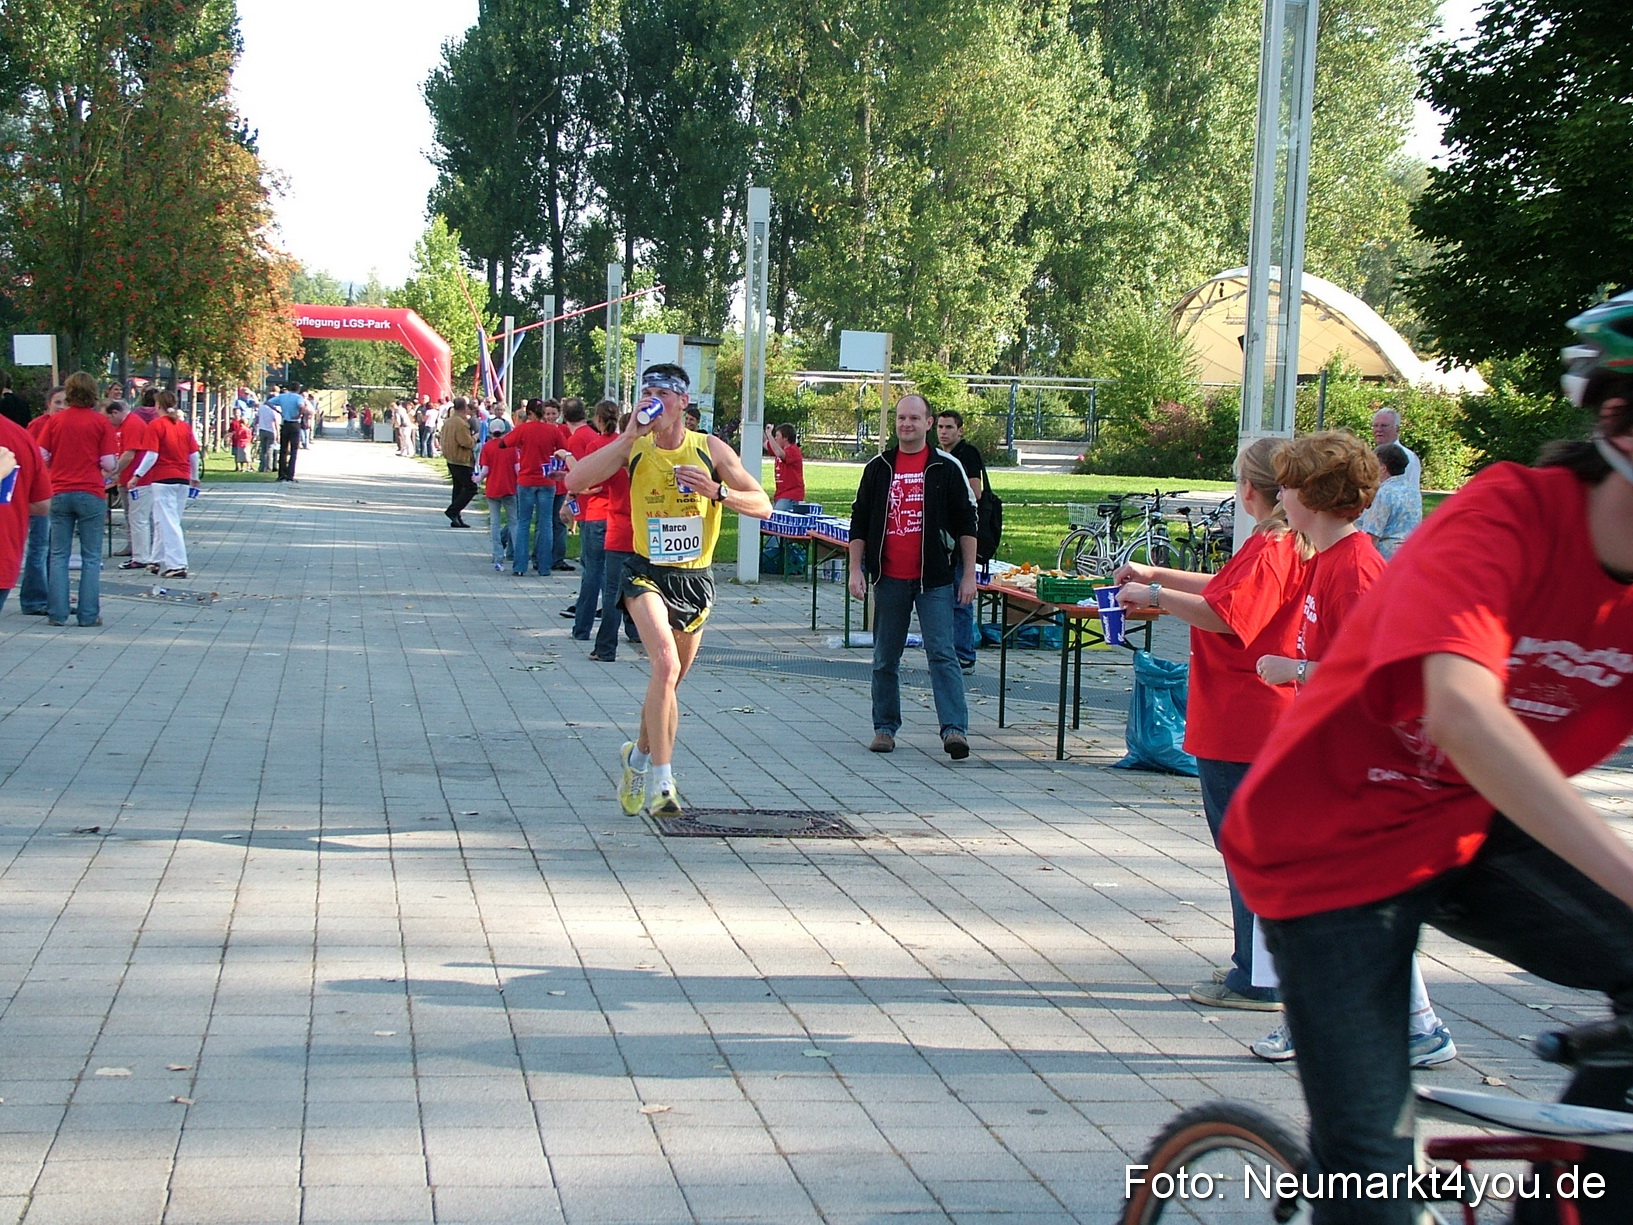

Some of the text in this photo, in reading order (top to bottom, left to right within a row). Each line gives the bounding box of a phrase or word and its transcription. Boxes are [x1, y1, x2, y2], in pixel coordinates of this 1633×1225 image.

[295, 316, 391, 329] pflegung LGS-Park
[662, 524, 687, 532] Marco
[664, 536, 699, 551] 2000
